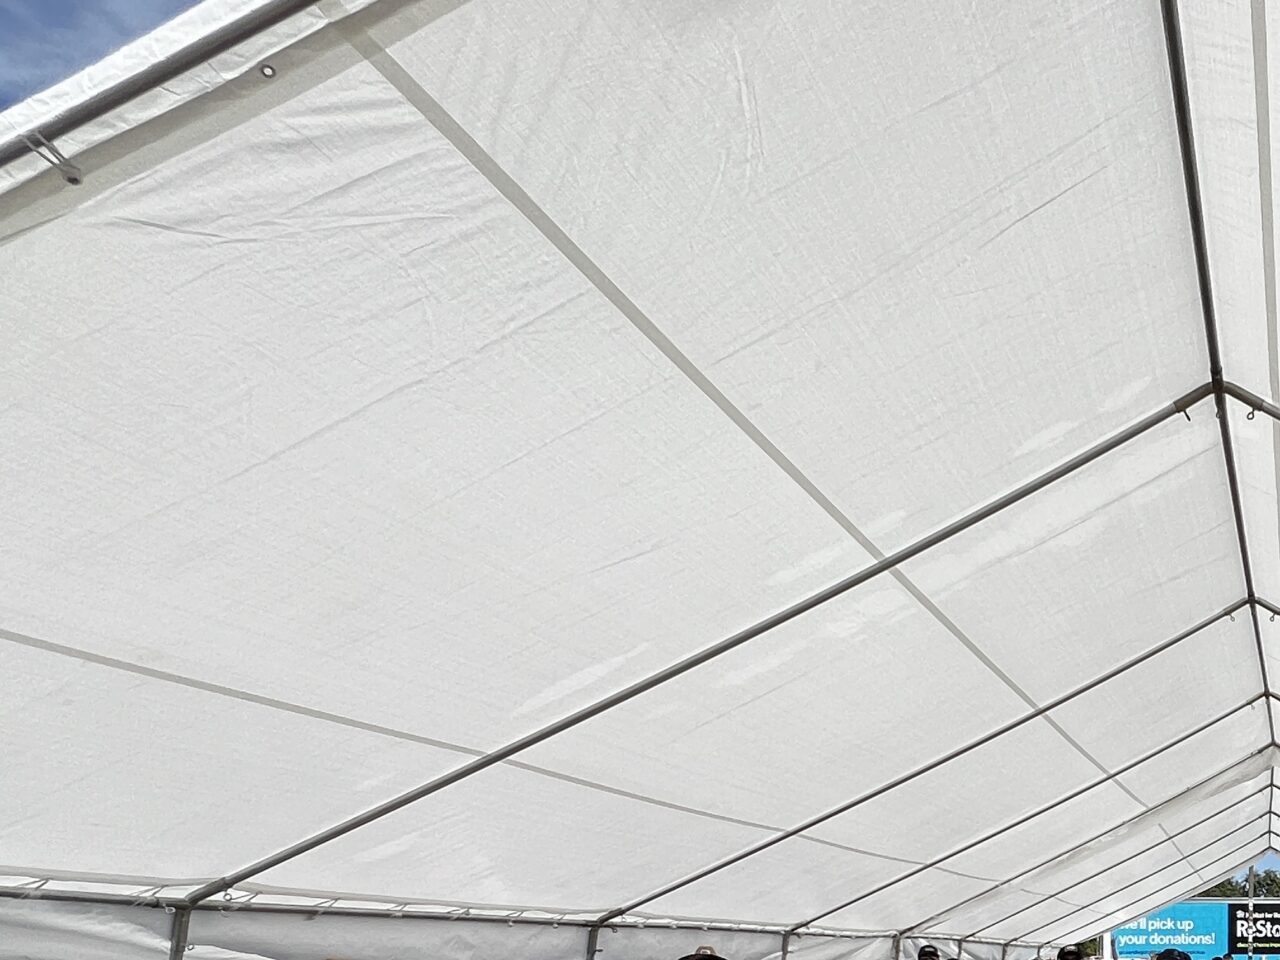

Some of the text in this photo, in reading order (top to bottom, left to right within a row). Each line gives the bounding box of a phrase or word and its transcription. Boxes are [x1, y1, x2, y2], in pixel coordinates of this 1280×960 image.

[1148, 917, 1175, 931] pick
[1176, 919, 1194, 931] up
[1119, 932, 1215, 946] your donations!
